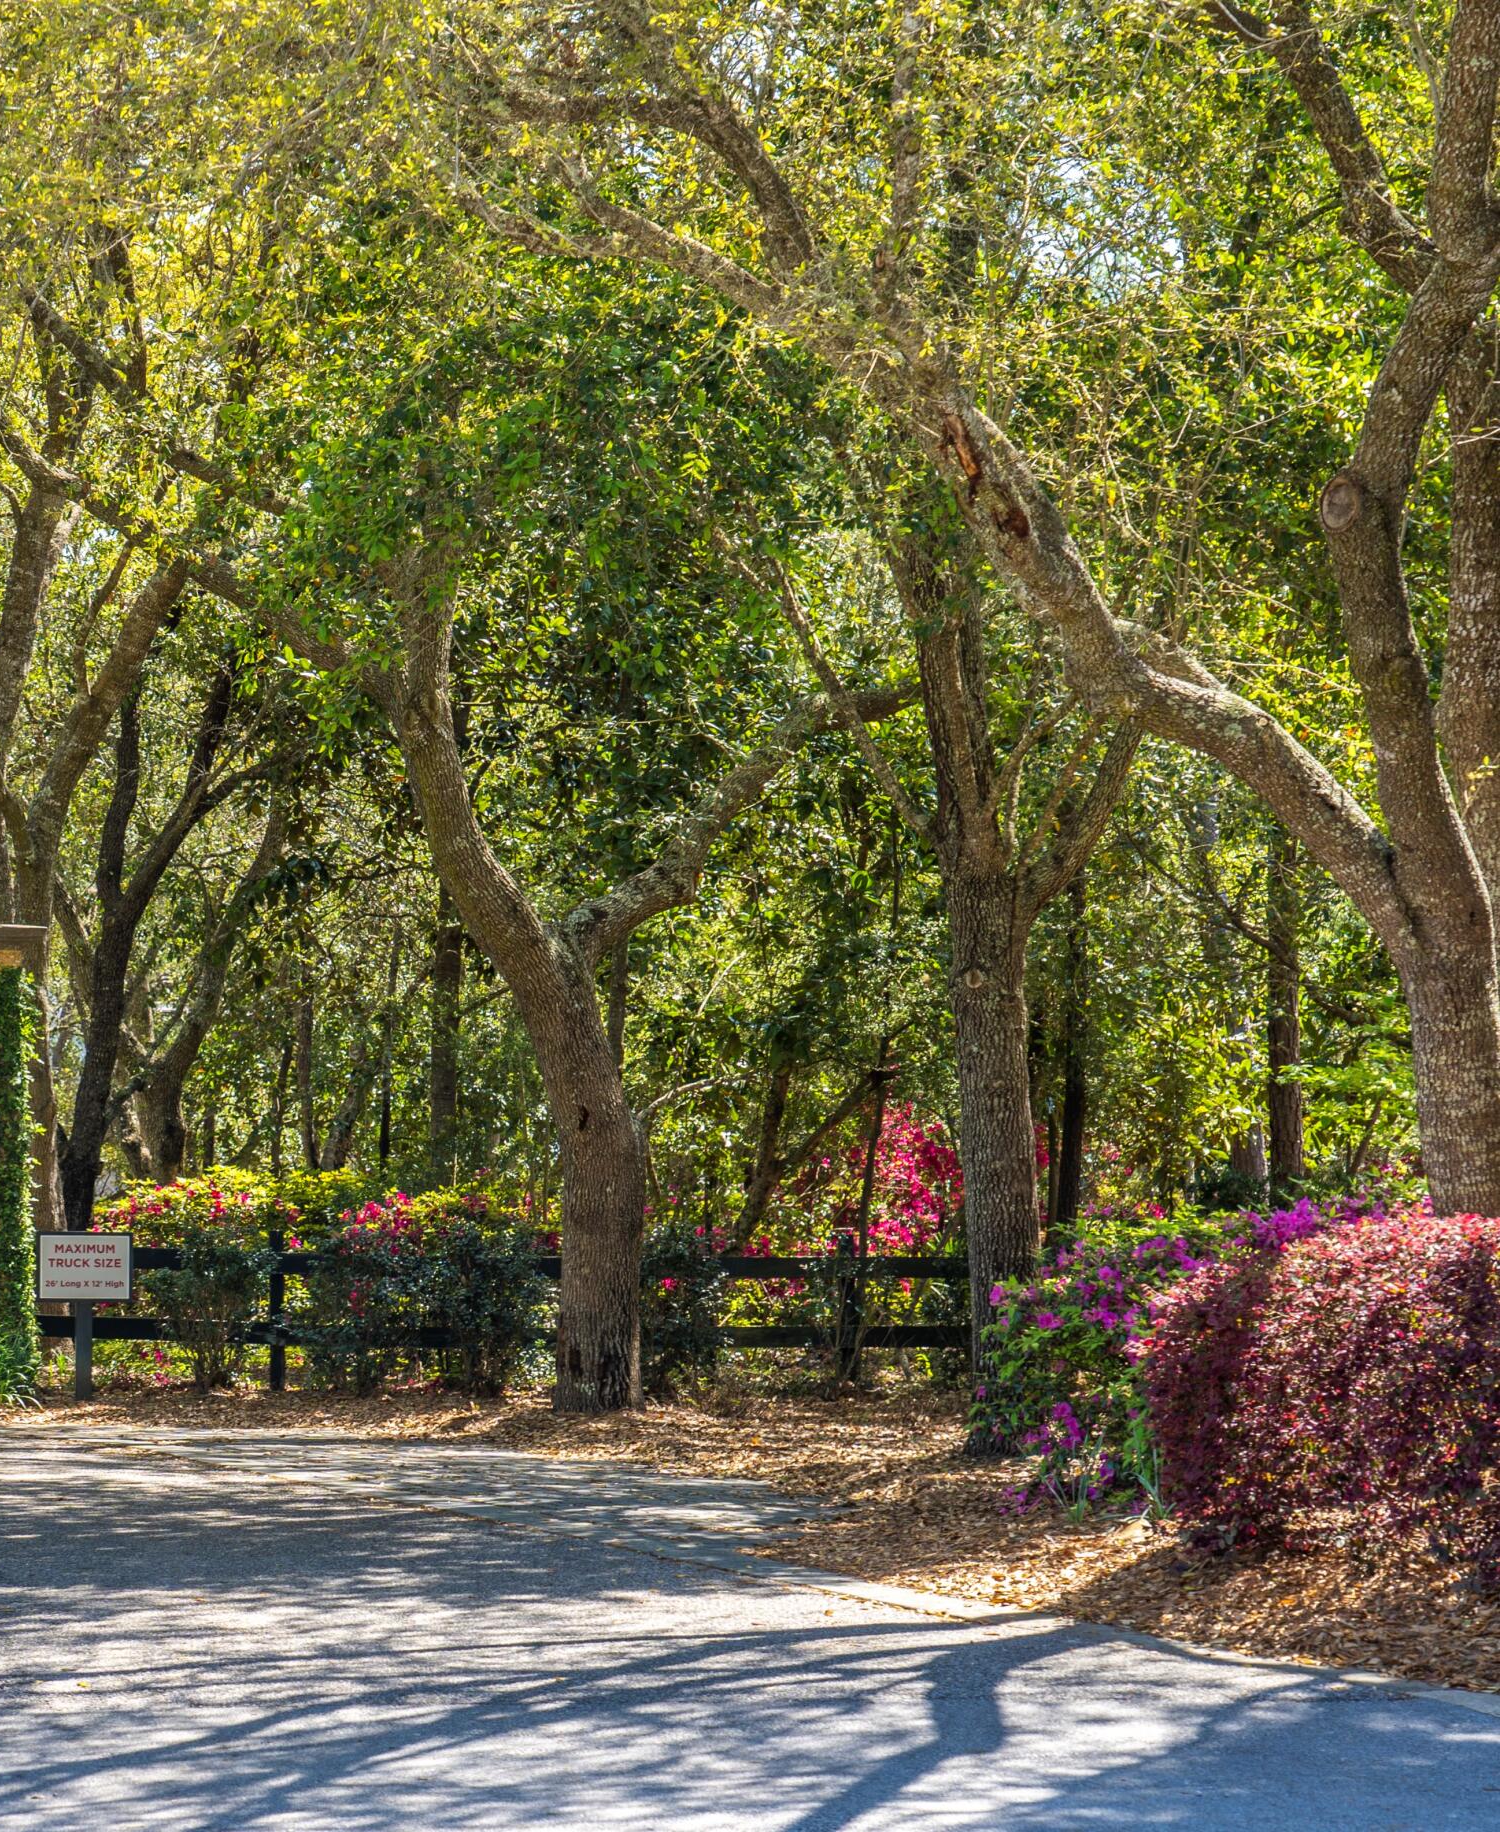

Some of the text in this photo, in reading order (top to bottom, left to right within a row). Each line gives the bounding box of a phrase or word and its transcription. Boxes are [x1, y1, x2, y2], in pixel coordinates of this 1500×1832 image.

[54, 1244, 116, 1254] MAXIMUM
[48, 1258, 122, 1268] TRUCK SIZE
[45, 1280, 125, 1289] 26' Long X 12' High
